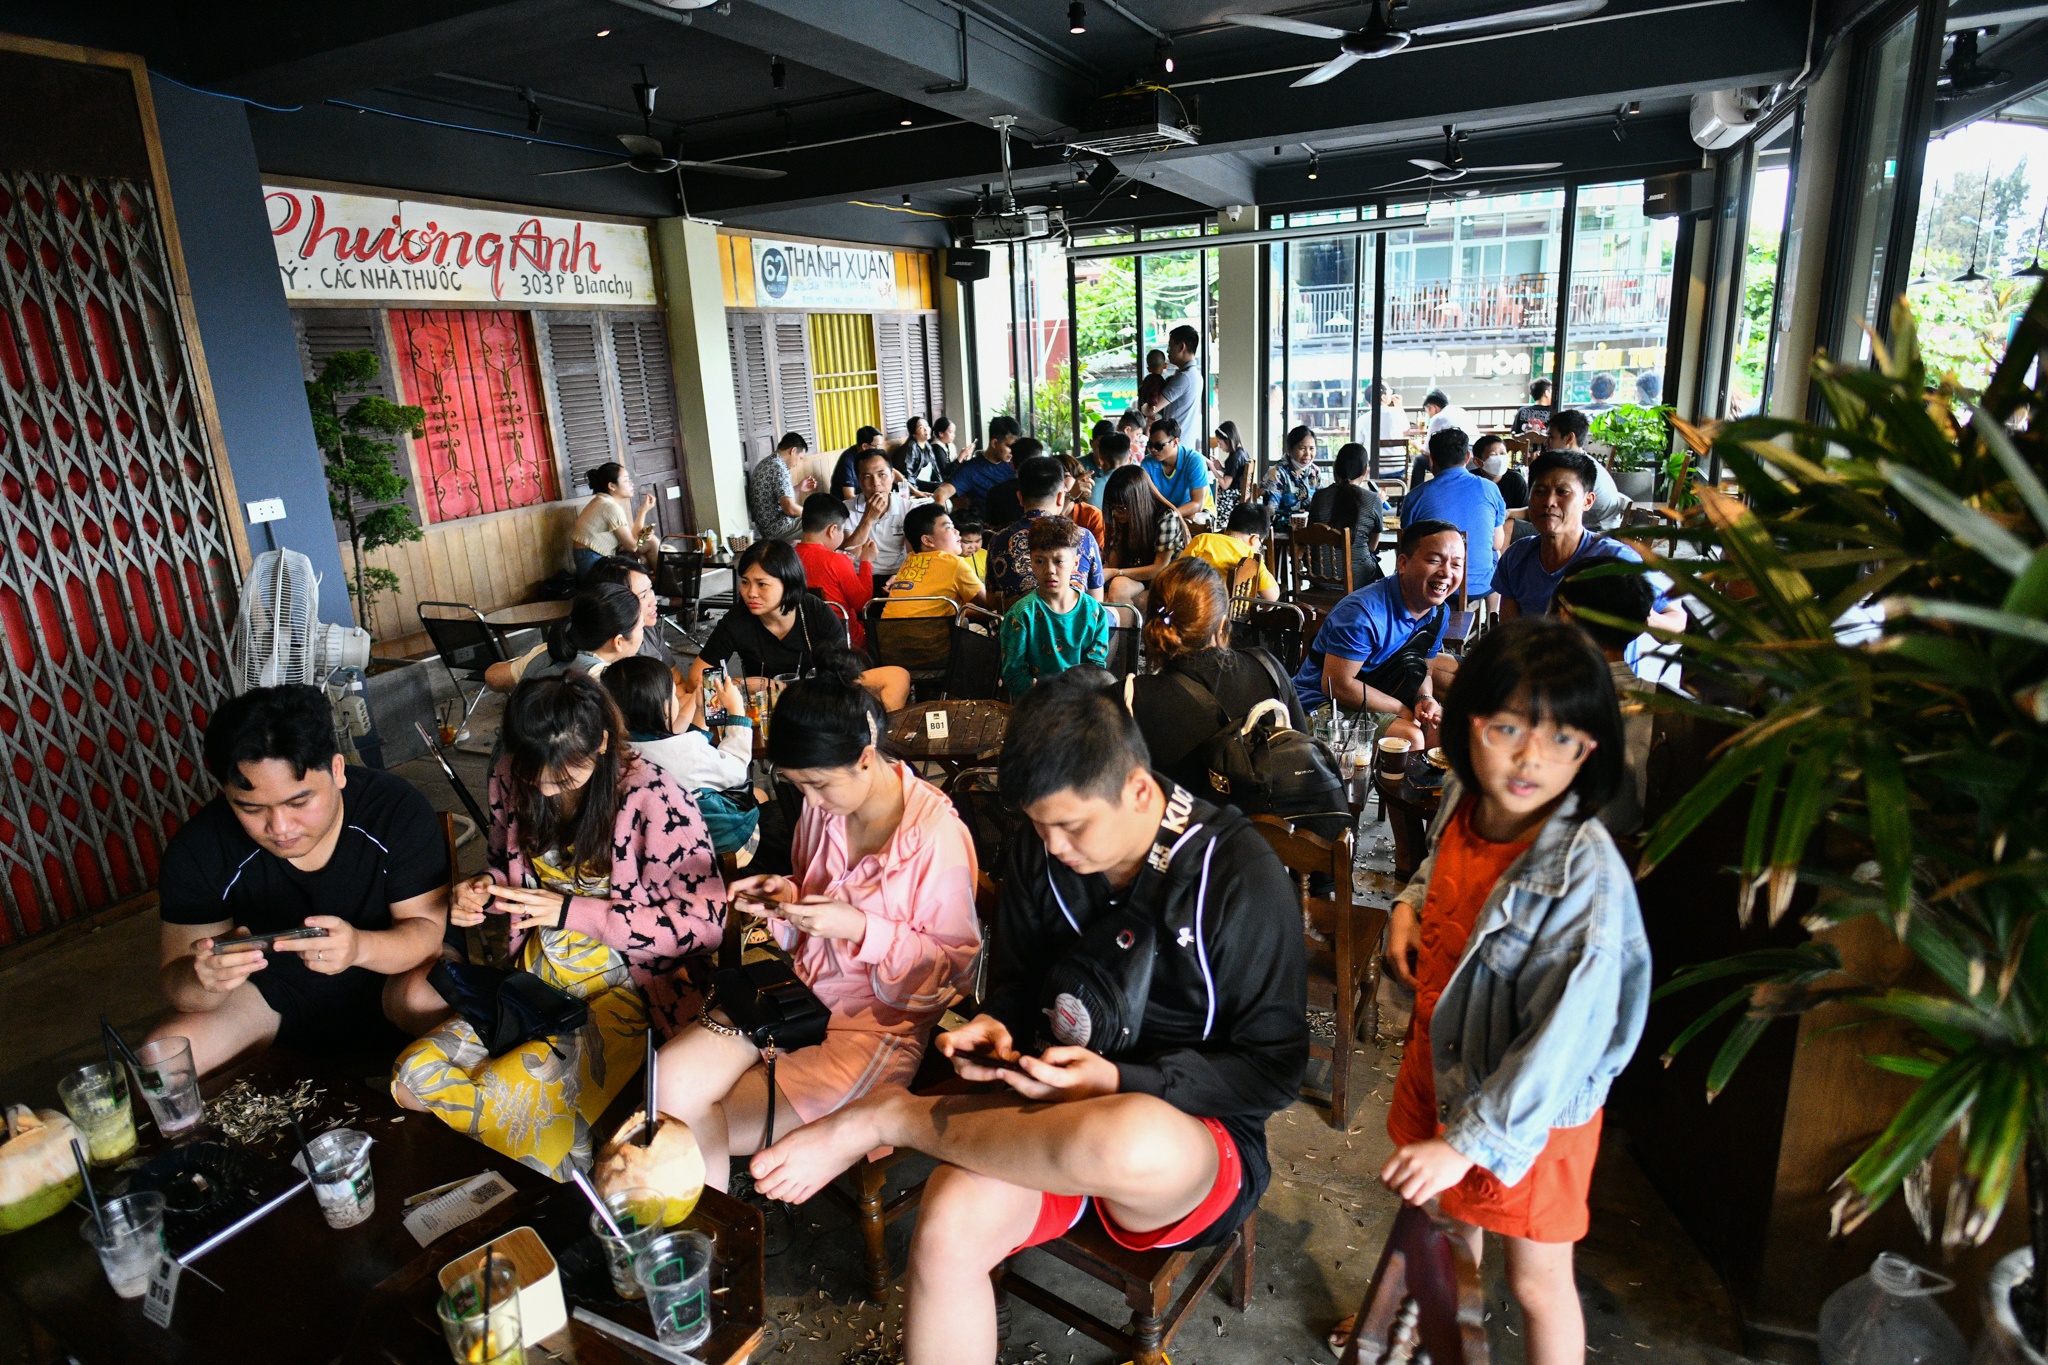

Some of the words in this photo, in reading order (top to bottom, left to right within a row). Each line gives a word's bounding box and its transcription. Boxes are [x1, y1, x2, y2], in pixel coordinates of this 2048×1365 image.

[510, 218, 602, 274] Anh
[321, 262, 357, 289] CÁC
[763, 254, 788, 283] 62
[574, 273, 632, 300] Blanchy
[930, 722, 945, 730] B01
